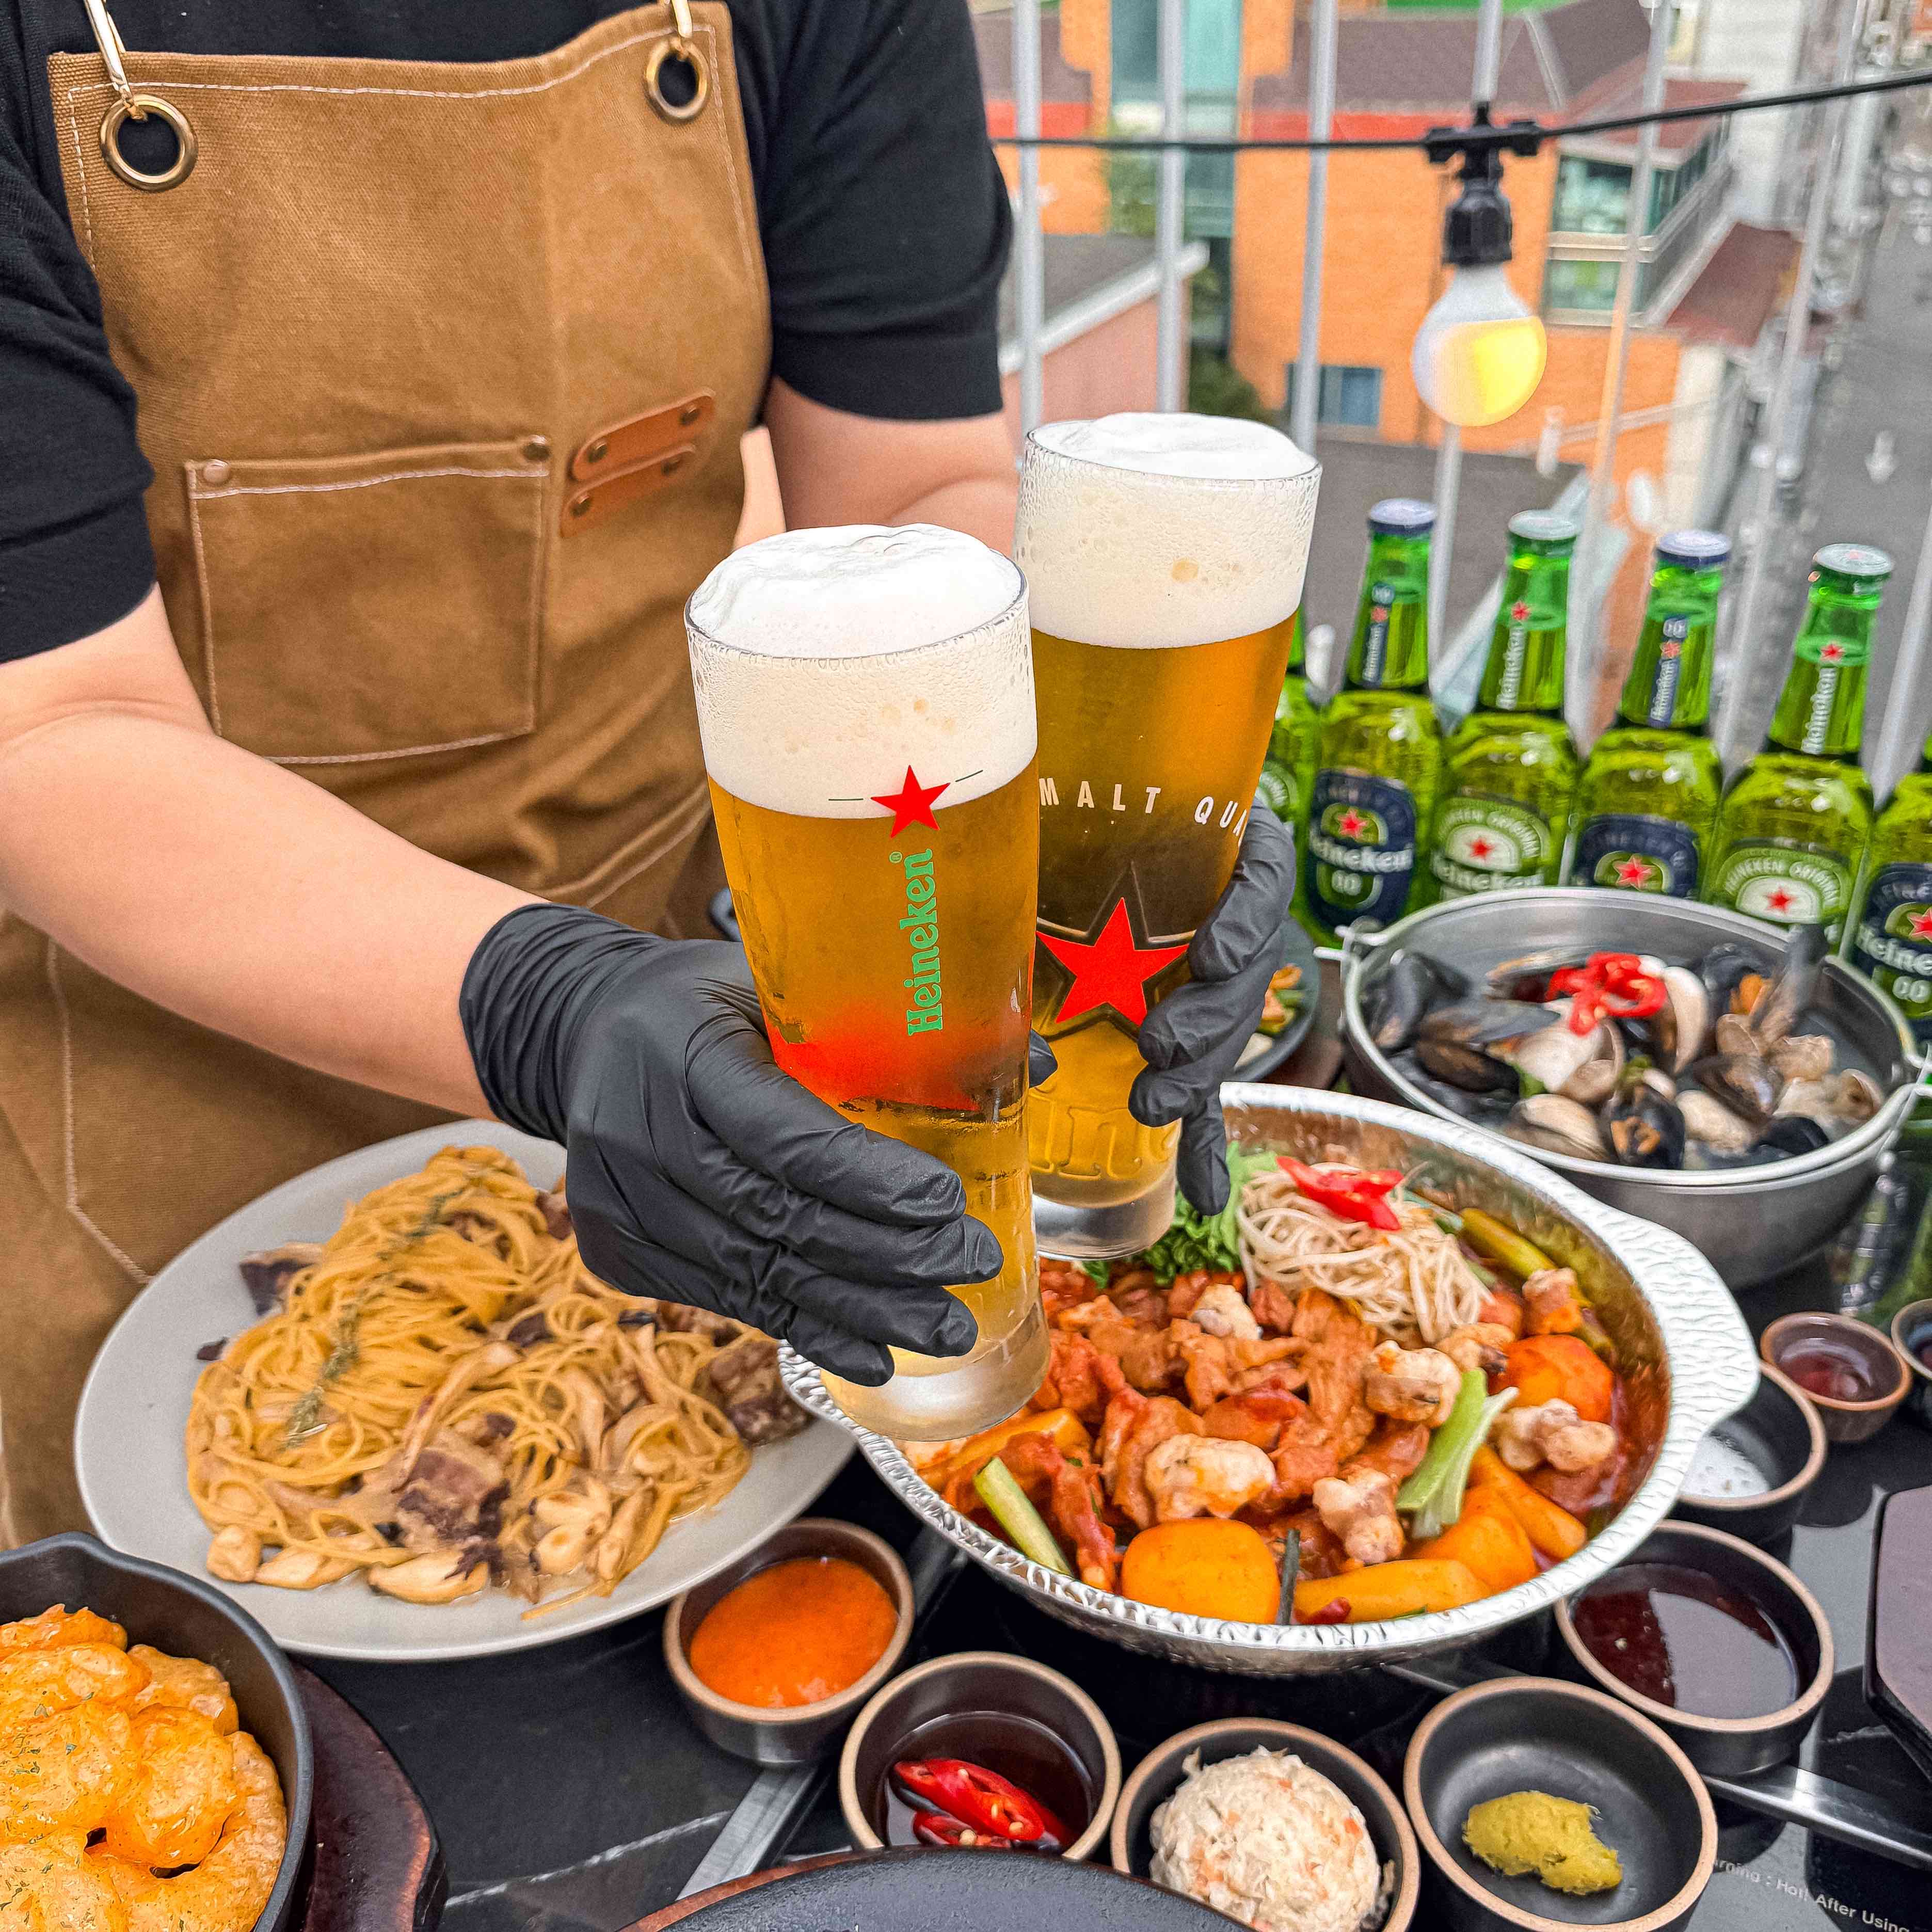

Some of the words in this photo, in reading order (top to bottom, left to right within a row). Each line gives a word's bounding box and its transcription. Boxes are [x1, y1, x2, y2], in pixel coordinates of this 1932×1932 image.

[1039, 777, 1161, 814] MALT
[900, 849, 943, 1036] Heineken
[1816, 1893, 1857, 1918] After
